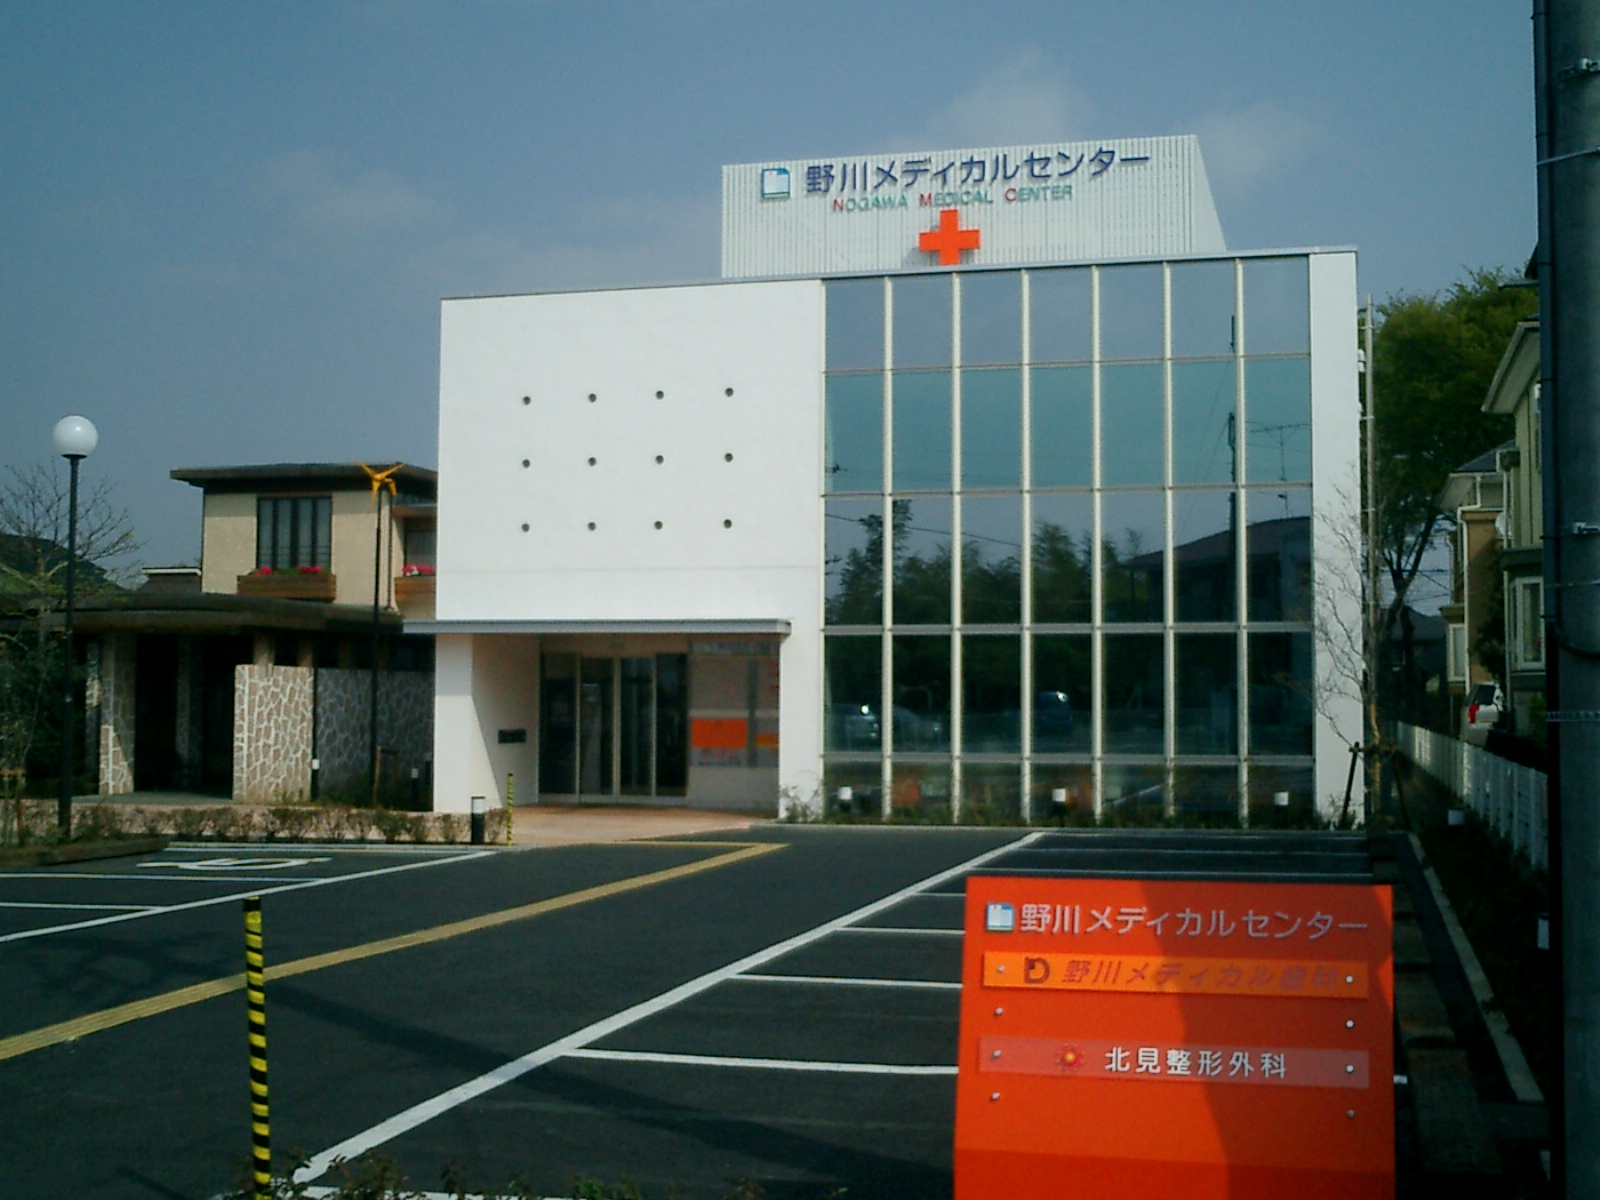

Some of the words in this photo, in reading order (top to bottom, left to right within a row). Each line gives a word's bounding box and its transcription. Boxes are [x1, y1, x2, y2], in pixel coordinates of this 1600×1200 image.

[805, 148, 1150, 194] 野川メディカルセンター
[833, 195, 908, 213] NOGAWA
[919, 188, 994, 208] MEDICAL
[1004, 184, 1074, 204] CENTER
[1020, 904, 1368, 939] 野川メディカルセンター
[1104, 1046, 1287, 1079] 北見整形外科
